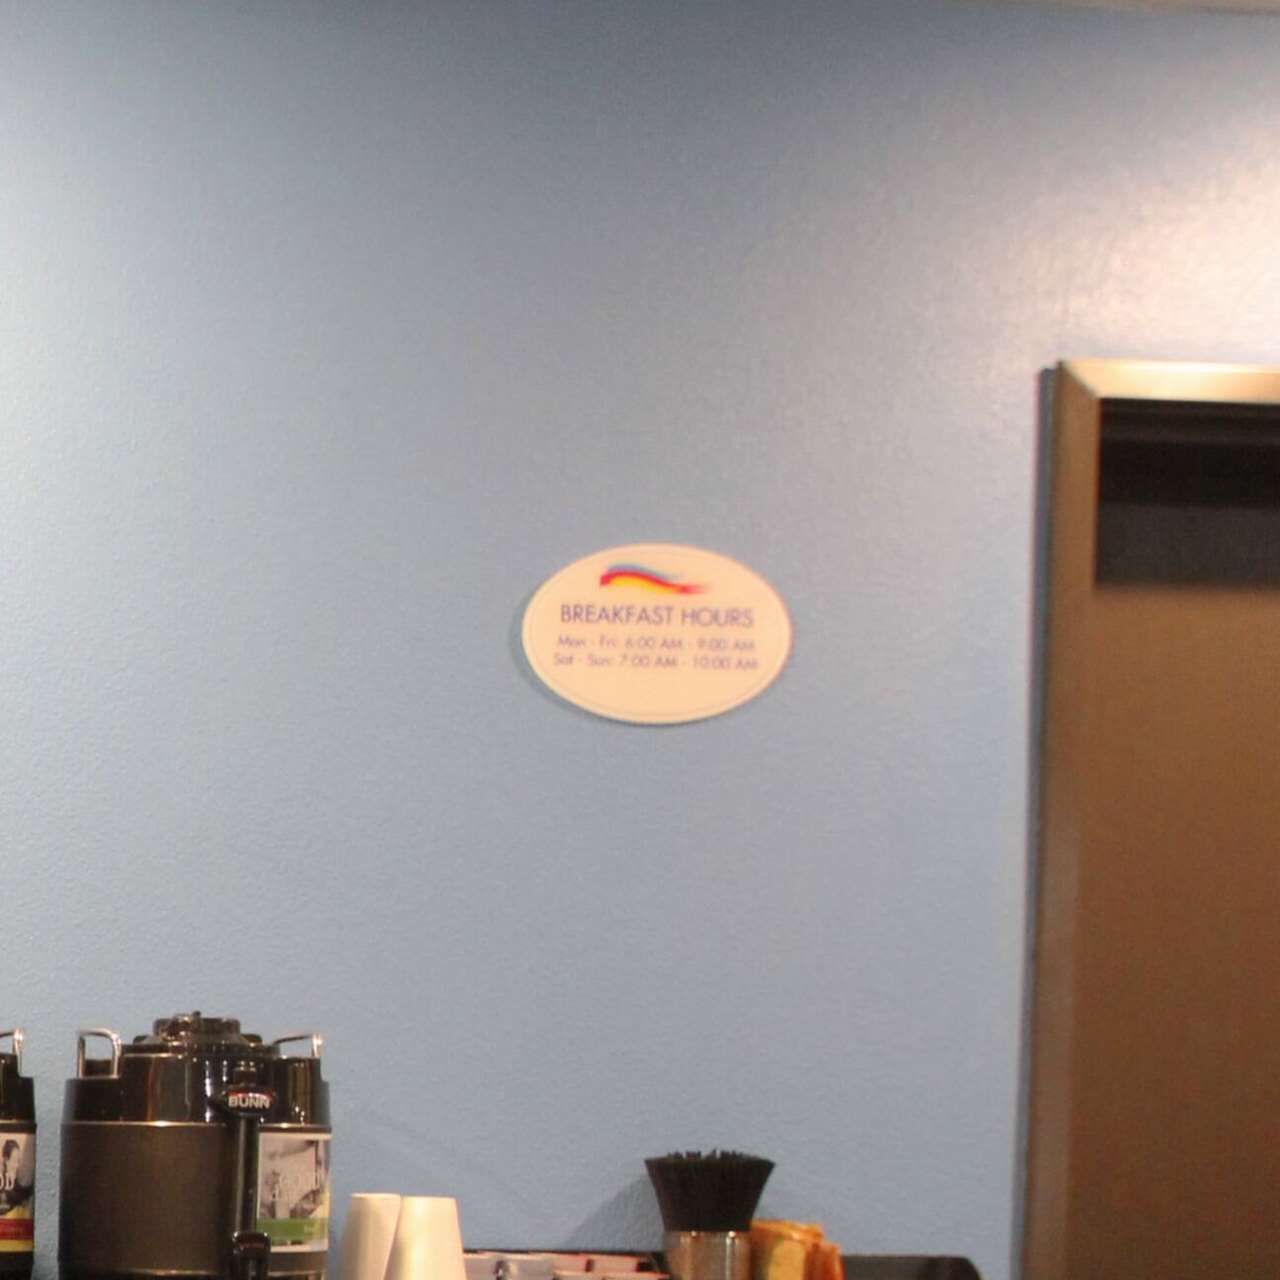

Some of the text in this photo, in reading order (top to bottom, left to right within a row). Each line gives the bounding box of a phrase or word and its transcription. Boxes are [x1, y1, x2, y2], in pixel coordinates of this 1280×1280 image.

[560, 604, 755, 628] BREAKFAST HOURS
[558, 635, 586, 648] Mon
[661, 638, 682, 650] AM
[734, 640, 755, 652] AM
[554, 652, 573, 665] Sat
[655, 656, 677, 668] AM
[735, 658, 759, 670] AM
[228, 1095, 270, 1108] BUNN
